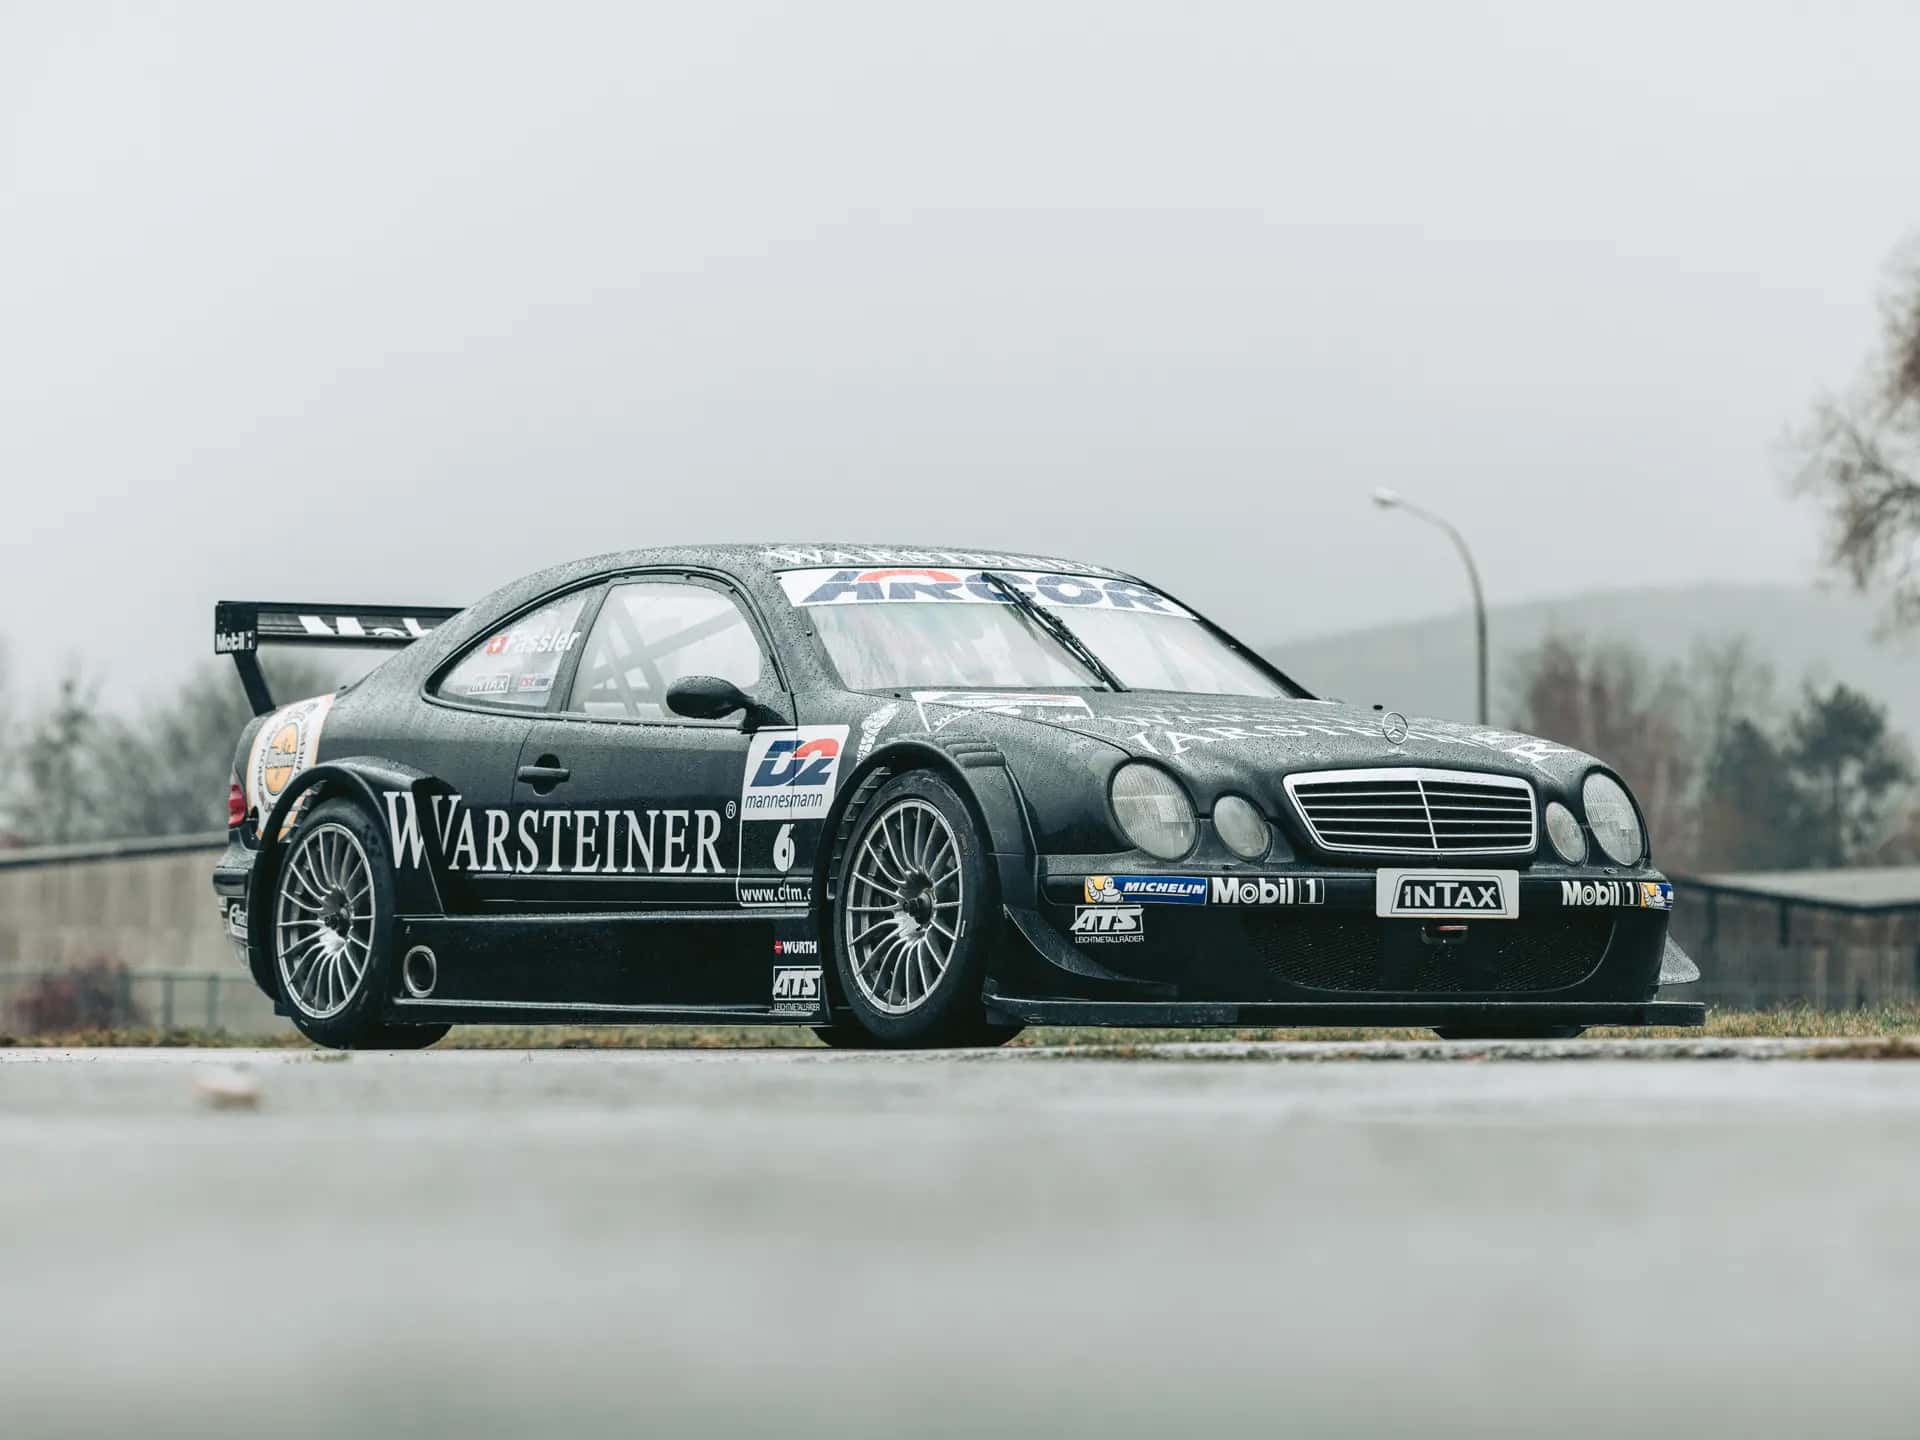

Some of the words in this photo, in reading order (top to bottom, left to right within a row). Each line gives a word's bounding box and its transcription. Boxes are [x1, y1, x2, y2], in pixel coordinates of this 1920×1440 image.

[800, 568, 1171, 612] ARCOR
[750, 738, 839, 787] D2
[745, 793, 823, 809] mannesmann
[773, 824, 795, 872] 6
[1123, 882, 1205, 894] MICHELIN
[1212, 877, 1293, 904] Mobil
[1305, 879, 1316, 903] 1
[1404, 882, 1496, 907] INTAX
[1561, 881, 1620, 906] Mobil
[1626, 882, 1634, 905] 1
[1070, 908, 1144, 930] ATS
[782, 940, 817, 954] WÜRTH
[772, 970, 824, 996] ATS
